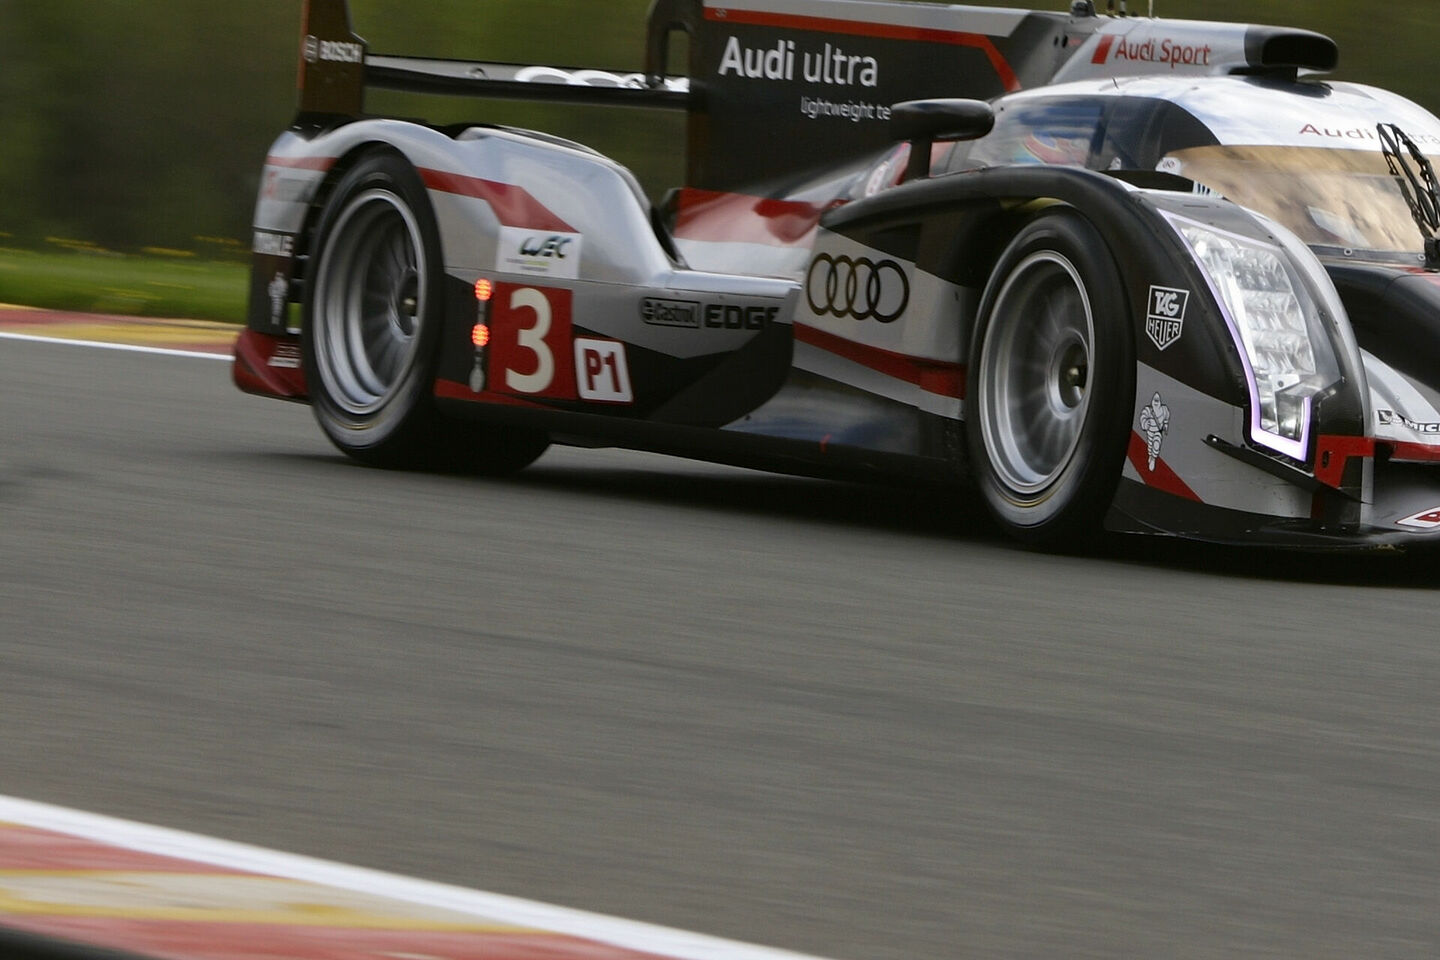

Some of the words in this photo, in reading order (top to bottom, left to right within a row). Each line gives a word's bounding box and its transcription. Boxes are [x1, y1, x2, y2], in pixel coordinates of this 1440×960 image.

[320, 40, 362, 63] BOSCH
[718, 35, 796, 81] Audi
[803, 42, 879, 87] ultra
[1115, 36, 1156, 62] Audi
[1160, 38, 1211, 68] Sport
[801, 96, 875, 122] lightweight
[1299, 123, 1375, 140] Audi
[519, 235, 573, 259] WEC
[655, 302, 696, 323] Castrol
[1154, 290, 1180, 317] TAG
[505, 287, 555, 393] 3
[1148, 319, 1180, 345] HEUER
[584, 348, 622, 393] P1
